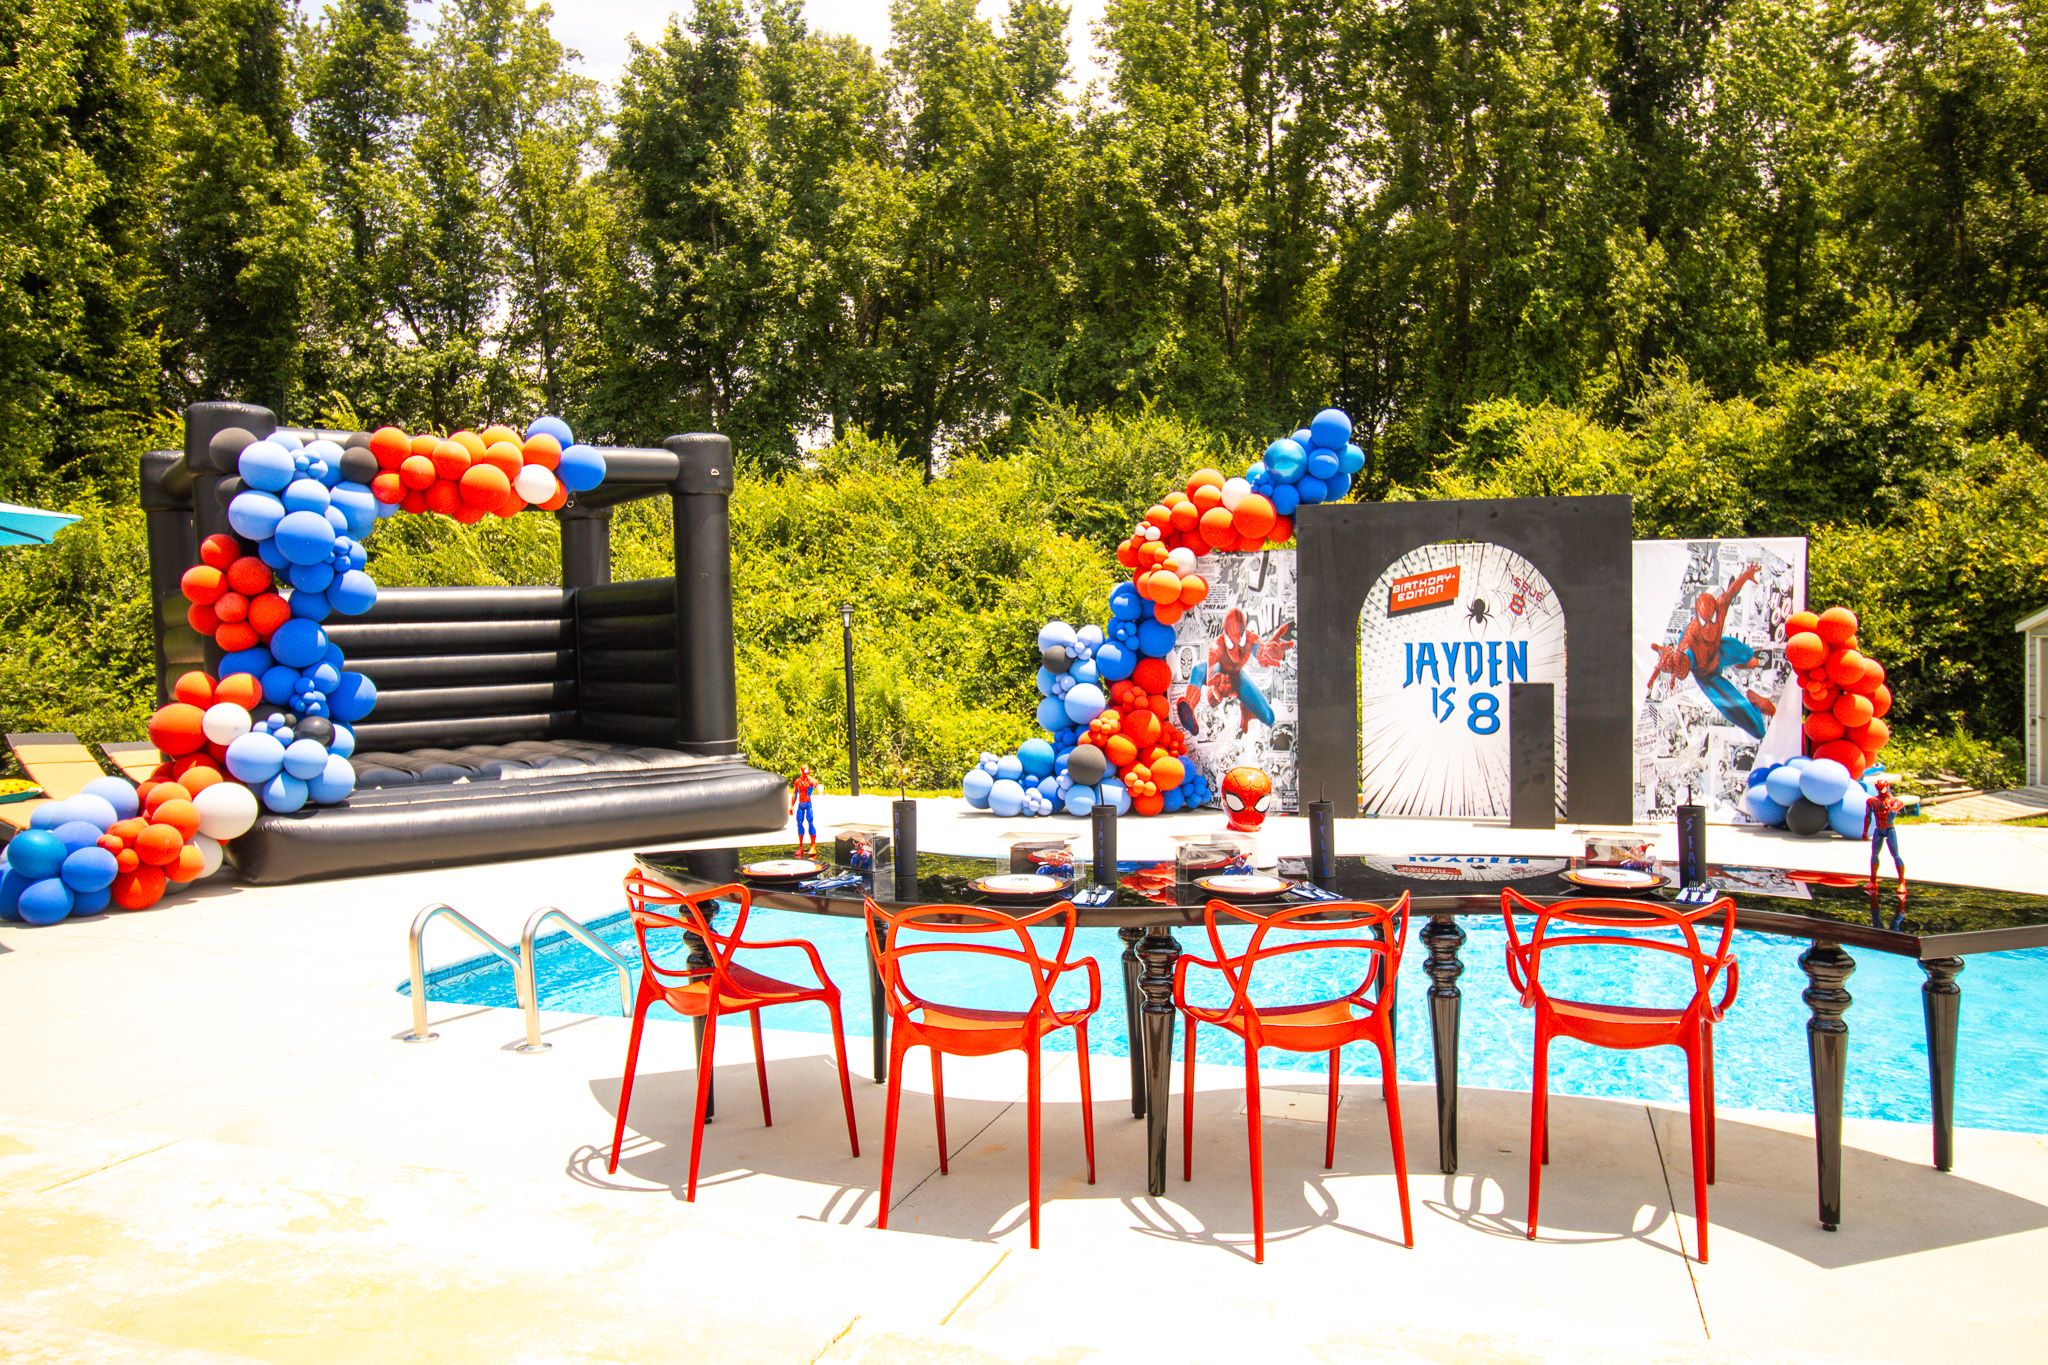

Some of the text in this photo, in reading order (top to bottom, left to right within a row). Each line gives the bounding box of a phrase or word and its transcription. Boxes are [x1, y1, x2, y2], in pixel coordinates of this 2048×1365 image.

[1397, 584, 1444, 602] EDITION
[1510, 593, 1525, 616] 8
[1511, 575, 1544, 602] ISSUE
[1403, 640, 1528, 688] JAYDEN
[1431, 687, 1500, 735] IS 8
[1686, 817, 1697, 878] SEAN
